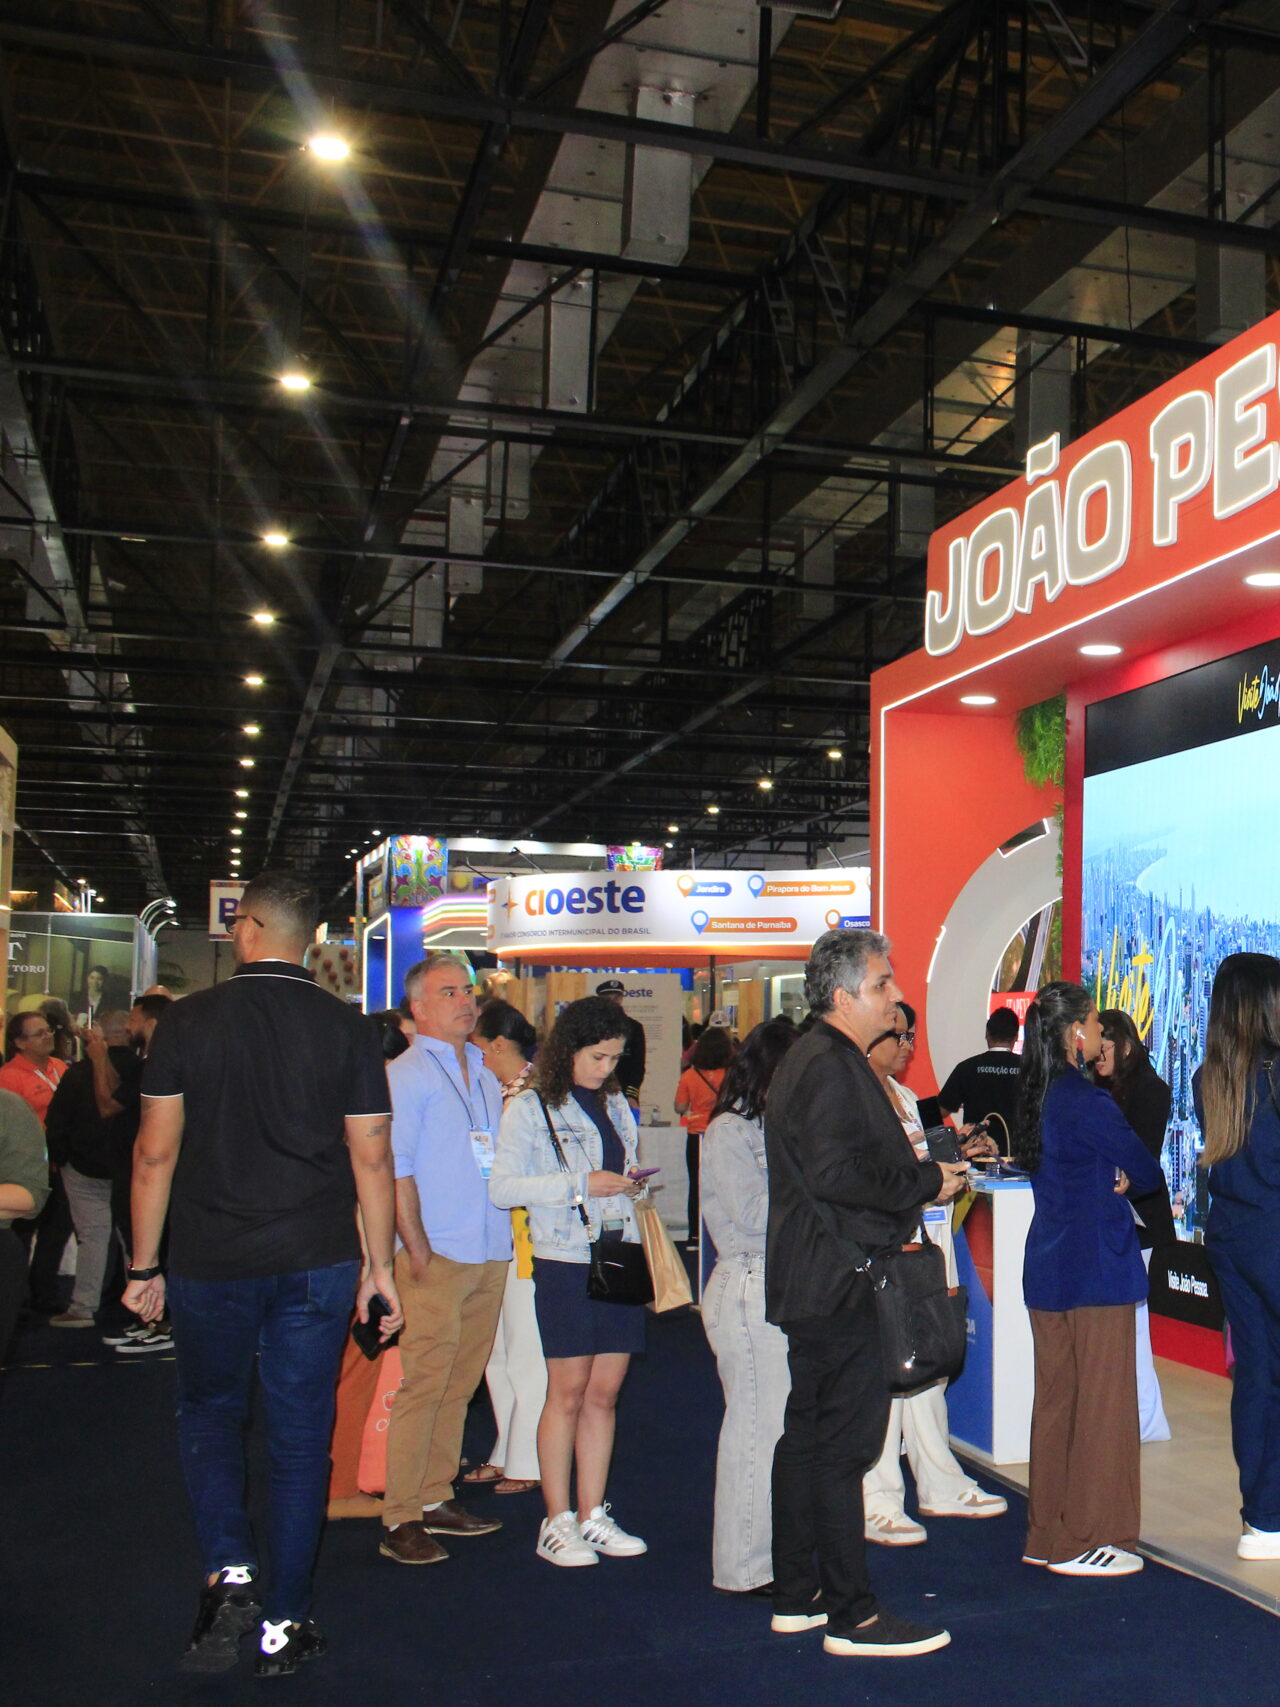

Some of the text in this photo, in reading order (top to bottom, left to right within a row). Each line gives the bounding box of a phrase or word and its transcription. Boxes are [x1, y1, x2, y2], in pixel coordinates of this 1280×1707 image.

[924, 433, 1132, 656] JOÃO
[711, 921, 745, 930] Santana
[746, 921, 756, 929] de
[621, 927, 651, 935] BRASIL
[12, 964, 46, 974] TORO
